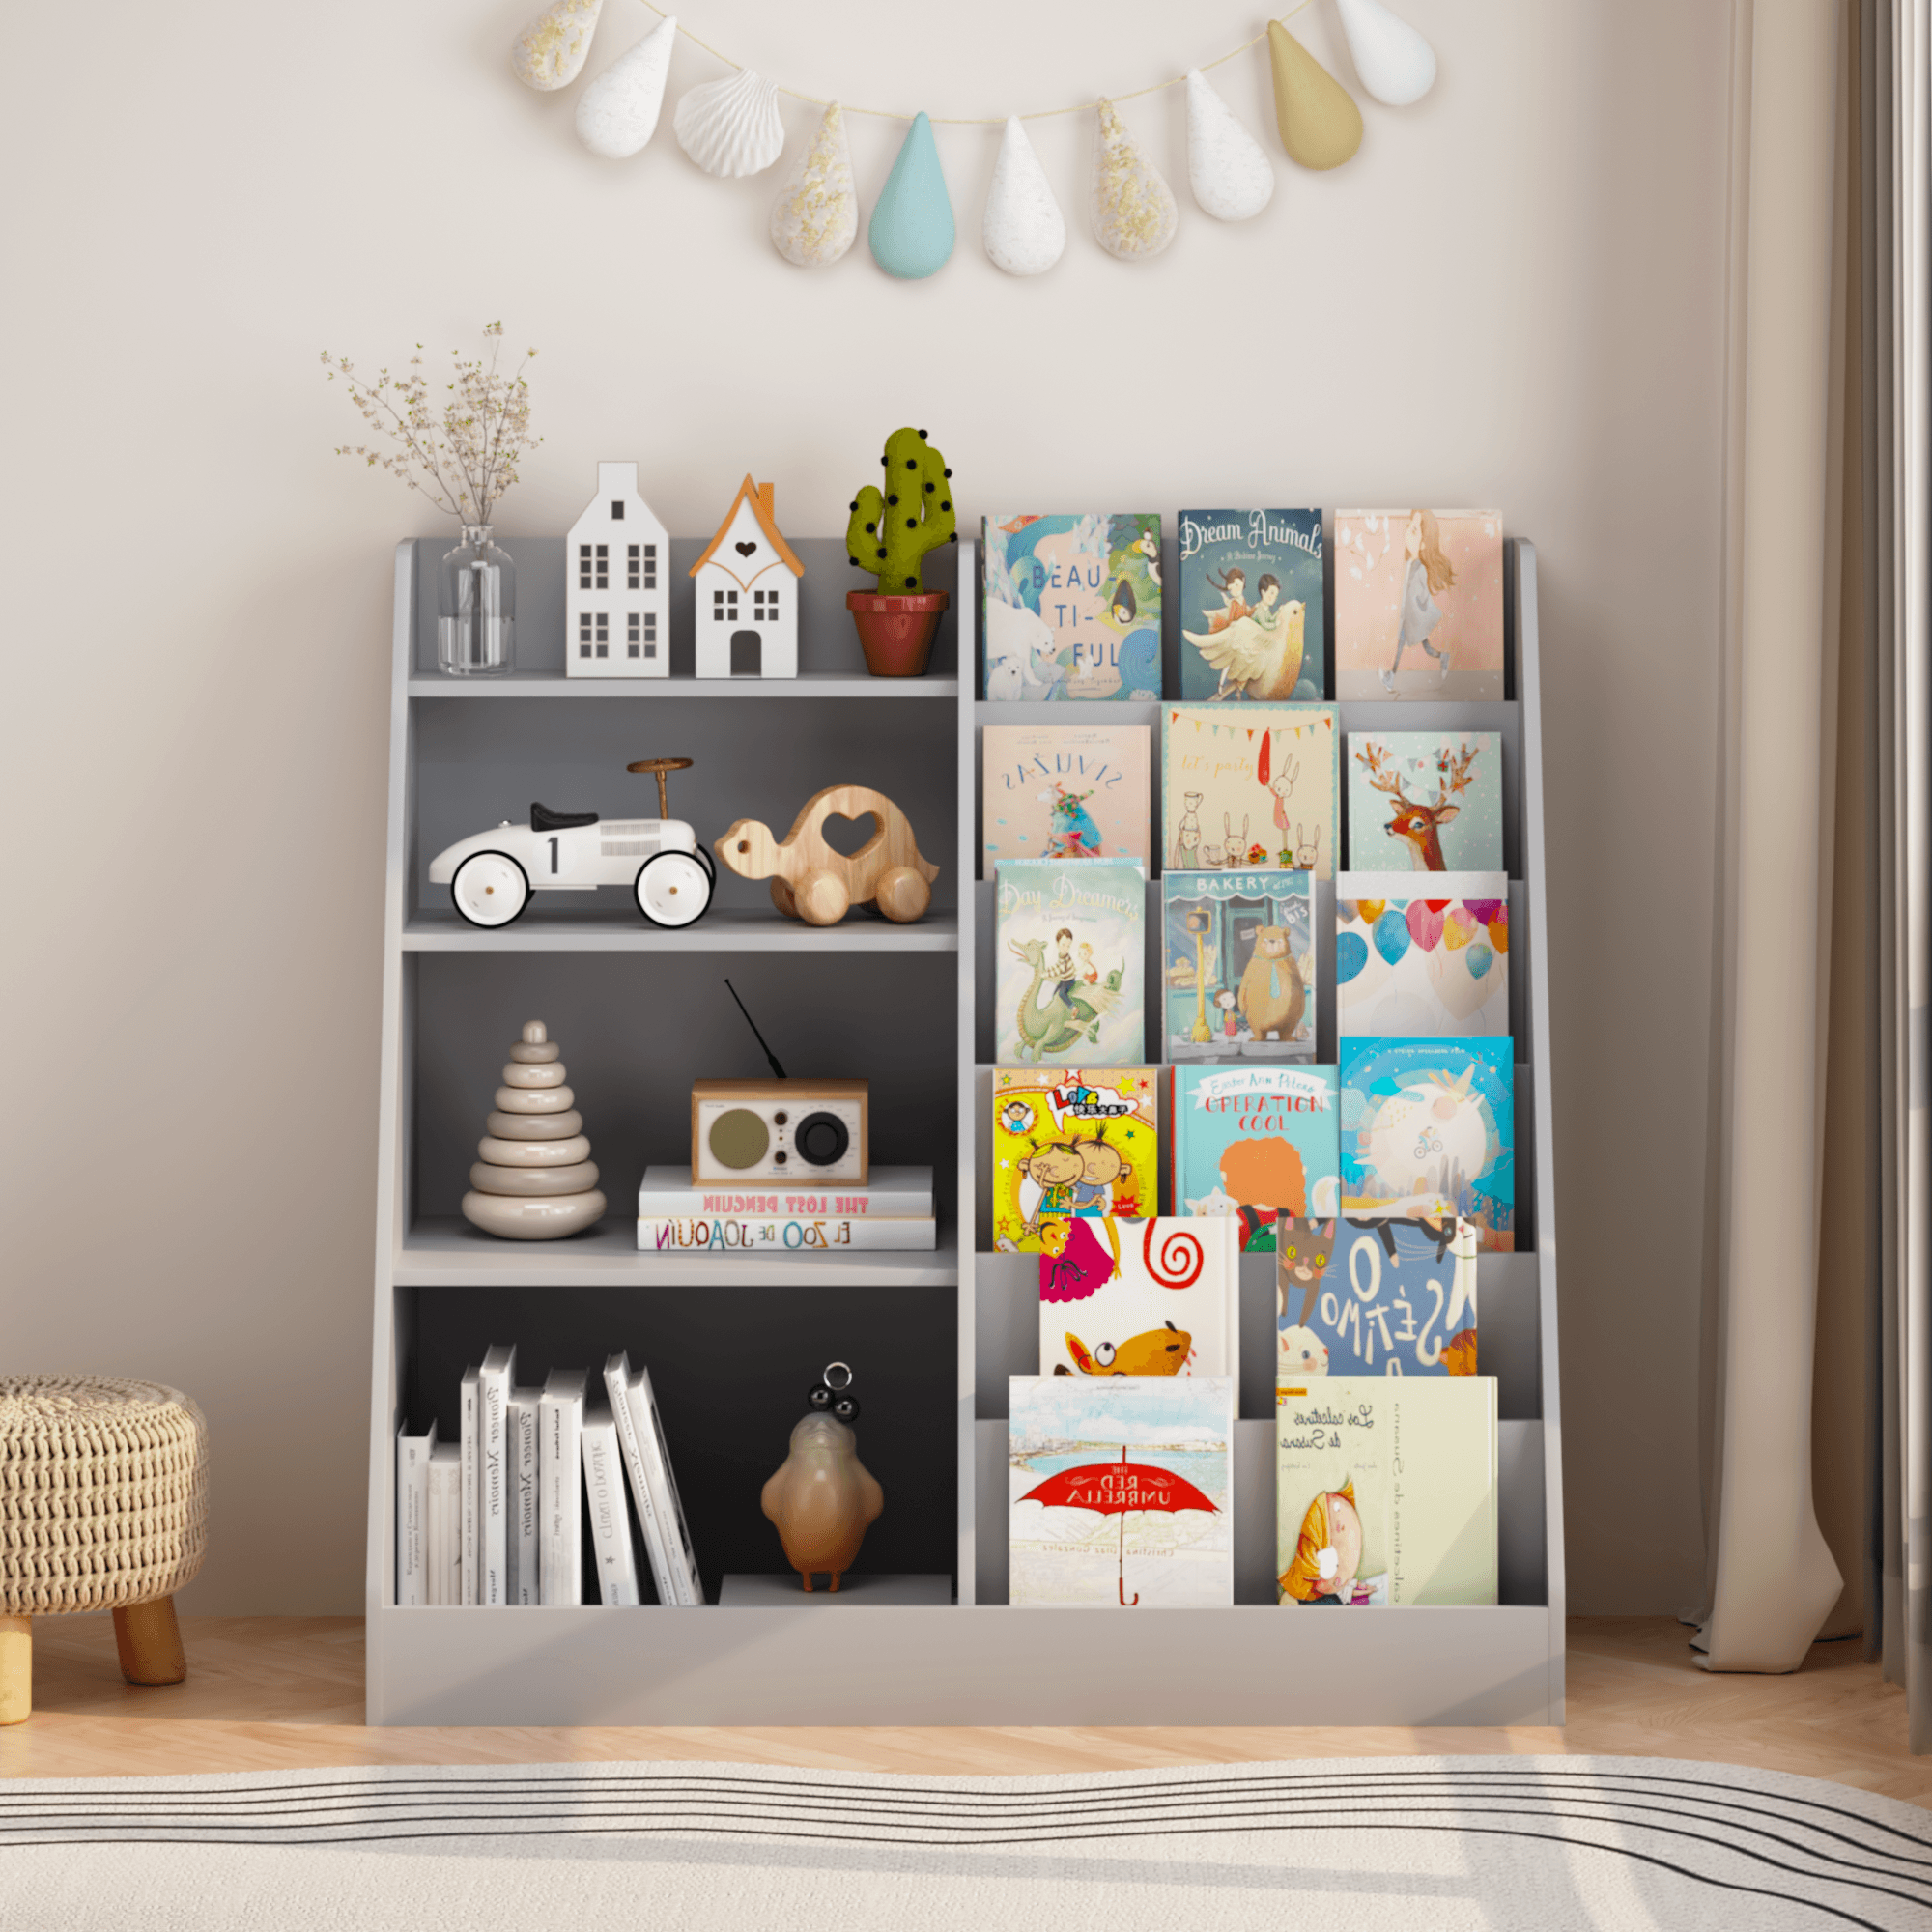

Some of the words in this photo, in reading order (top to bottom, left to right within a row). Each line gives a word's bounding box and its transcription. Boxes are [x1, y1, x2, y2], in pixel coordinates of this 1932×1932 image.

[1179, 515, 1244, 561] Dream
[1247, 508, 1322, 559] Animals
[1073, 643, 1119, 667] FUL
[1213, 757, 1255, 781] party
[547, 837, 558, 875] 1
[1196, 876, 1269, 892] BAKERY
[998, 878, 1042, 917] Day
[1049, 872, 1139, 921] Dreamers
[1205, 1095, 1323, 1113] OPERATION
[1238, 1114, 1290, 1132] COOL
